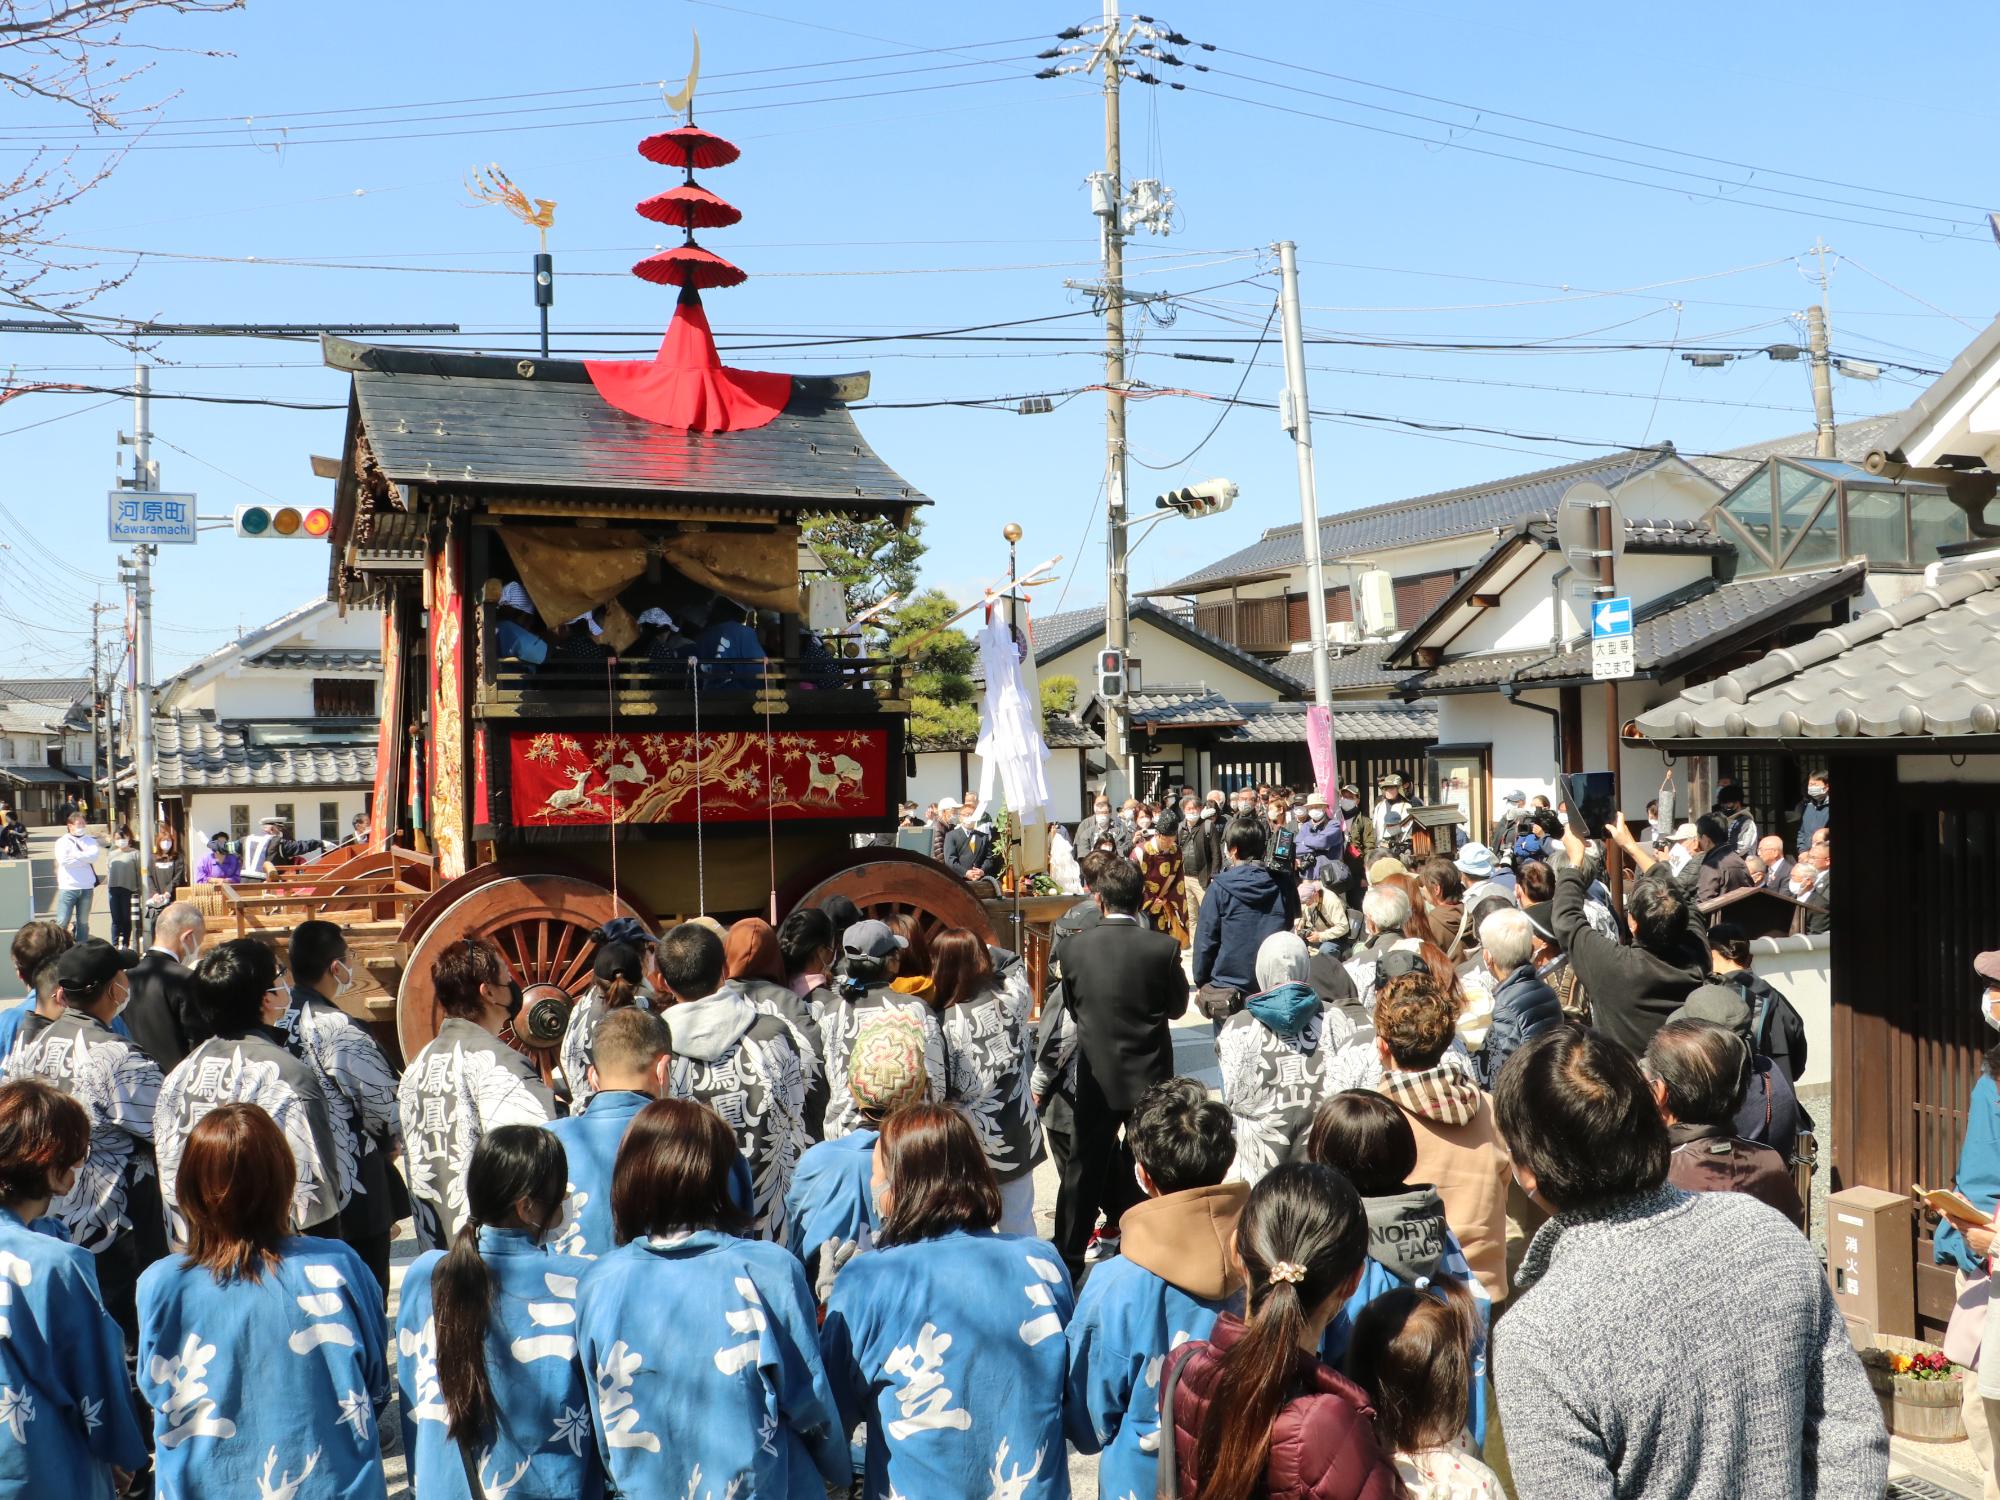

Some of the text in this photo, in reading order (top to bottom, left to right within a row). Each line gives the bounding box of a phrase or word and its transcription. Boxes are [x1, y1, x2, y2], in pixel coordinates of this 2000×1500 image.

[118, 501, 187, 522] 河原町
[115, 523, 190, 535] Kawaramachi
[1596, 639, 1628, 656] 大型等
[1595, 661, 1631, 675] ここまで
[417, 1053, 453, 1161] 鳳凰山
[1368, 1216, 1439, 1245] NORTH
